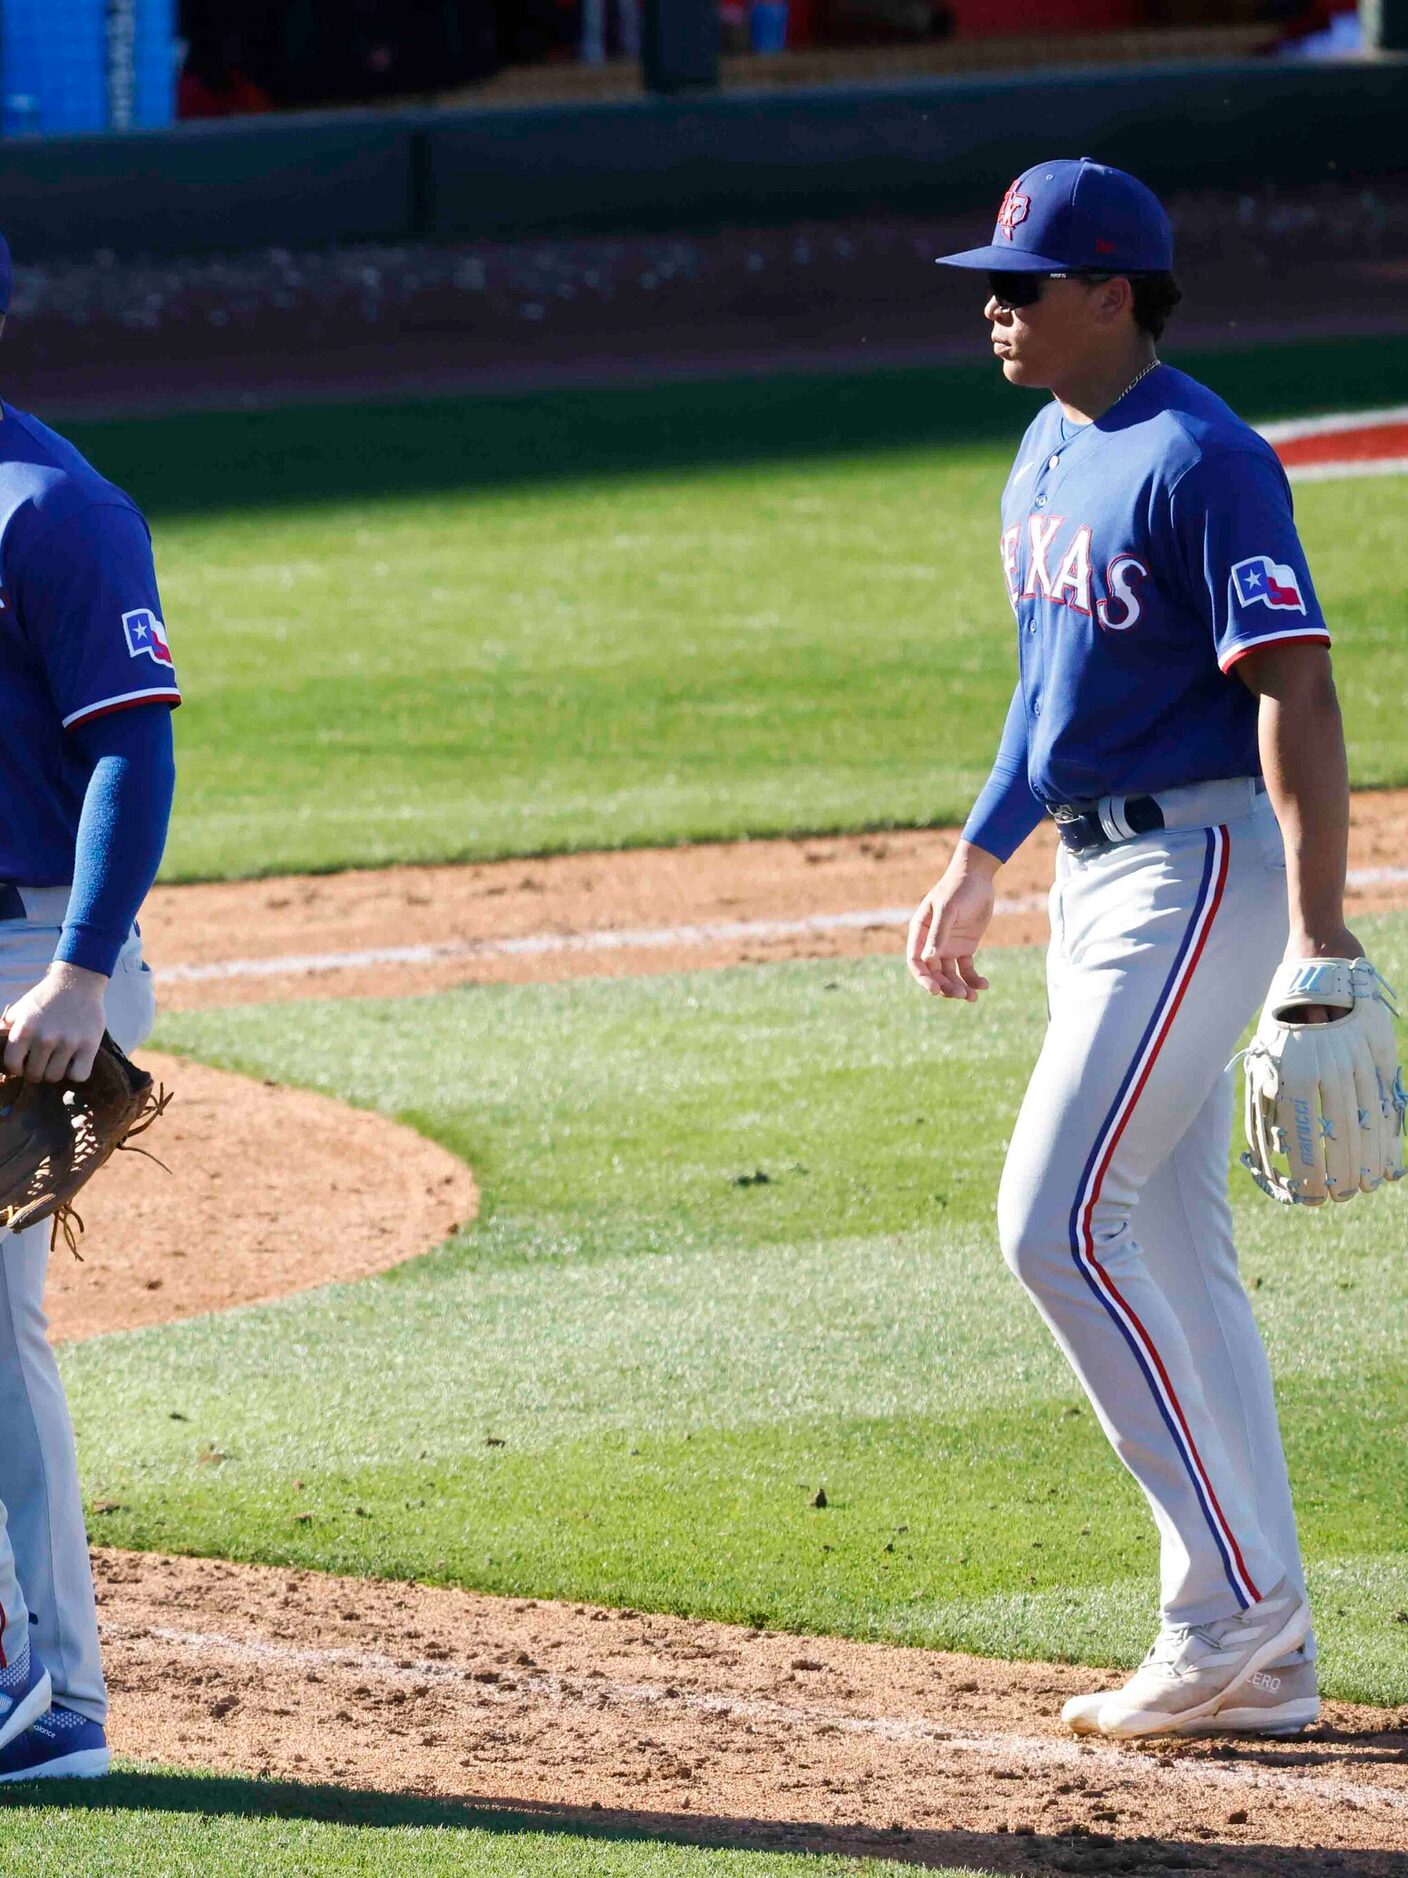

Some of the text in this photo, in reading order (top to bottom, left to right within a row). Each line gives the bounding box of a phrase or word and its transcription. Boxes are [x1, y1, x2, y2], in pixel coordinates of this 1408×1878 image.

[999, 513, 1149, 632] EXAS
[1291, 1097, 1314, 1167] marucci
[1245, 1671, 1282, 1692] ERO
[32, 1724, 56, 1740] alance
